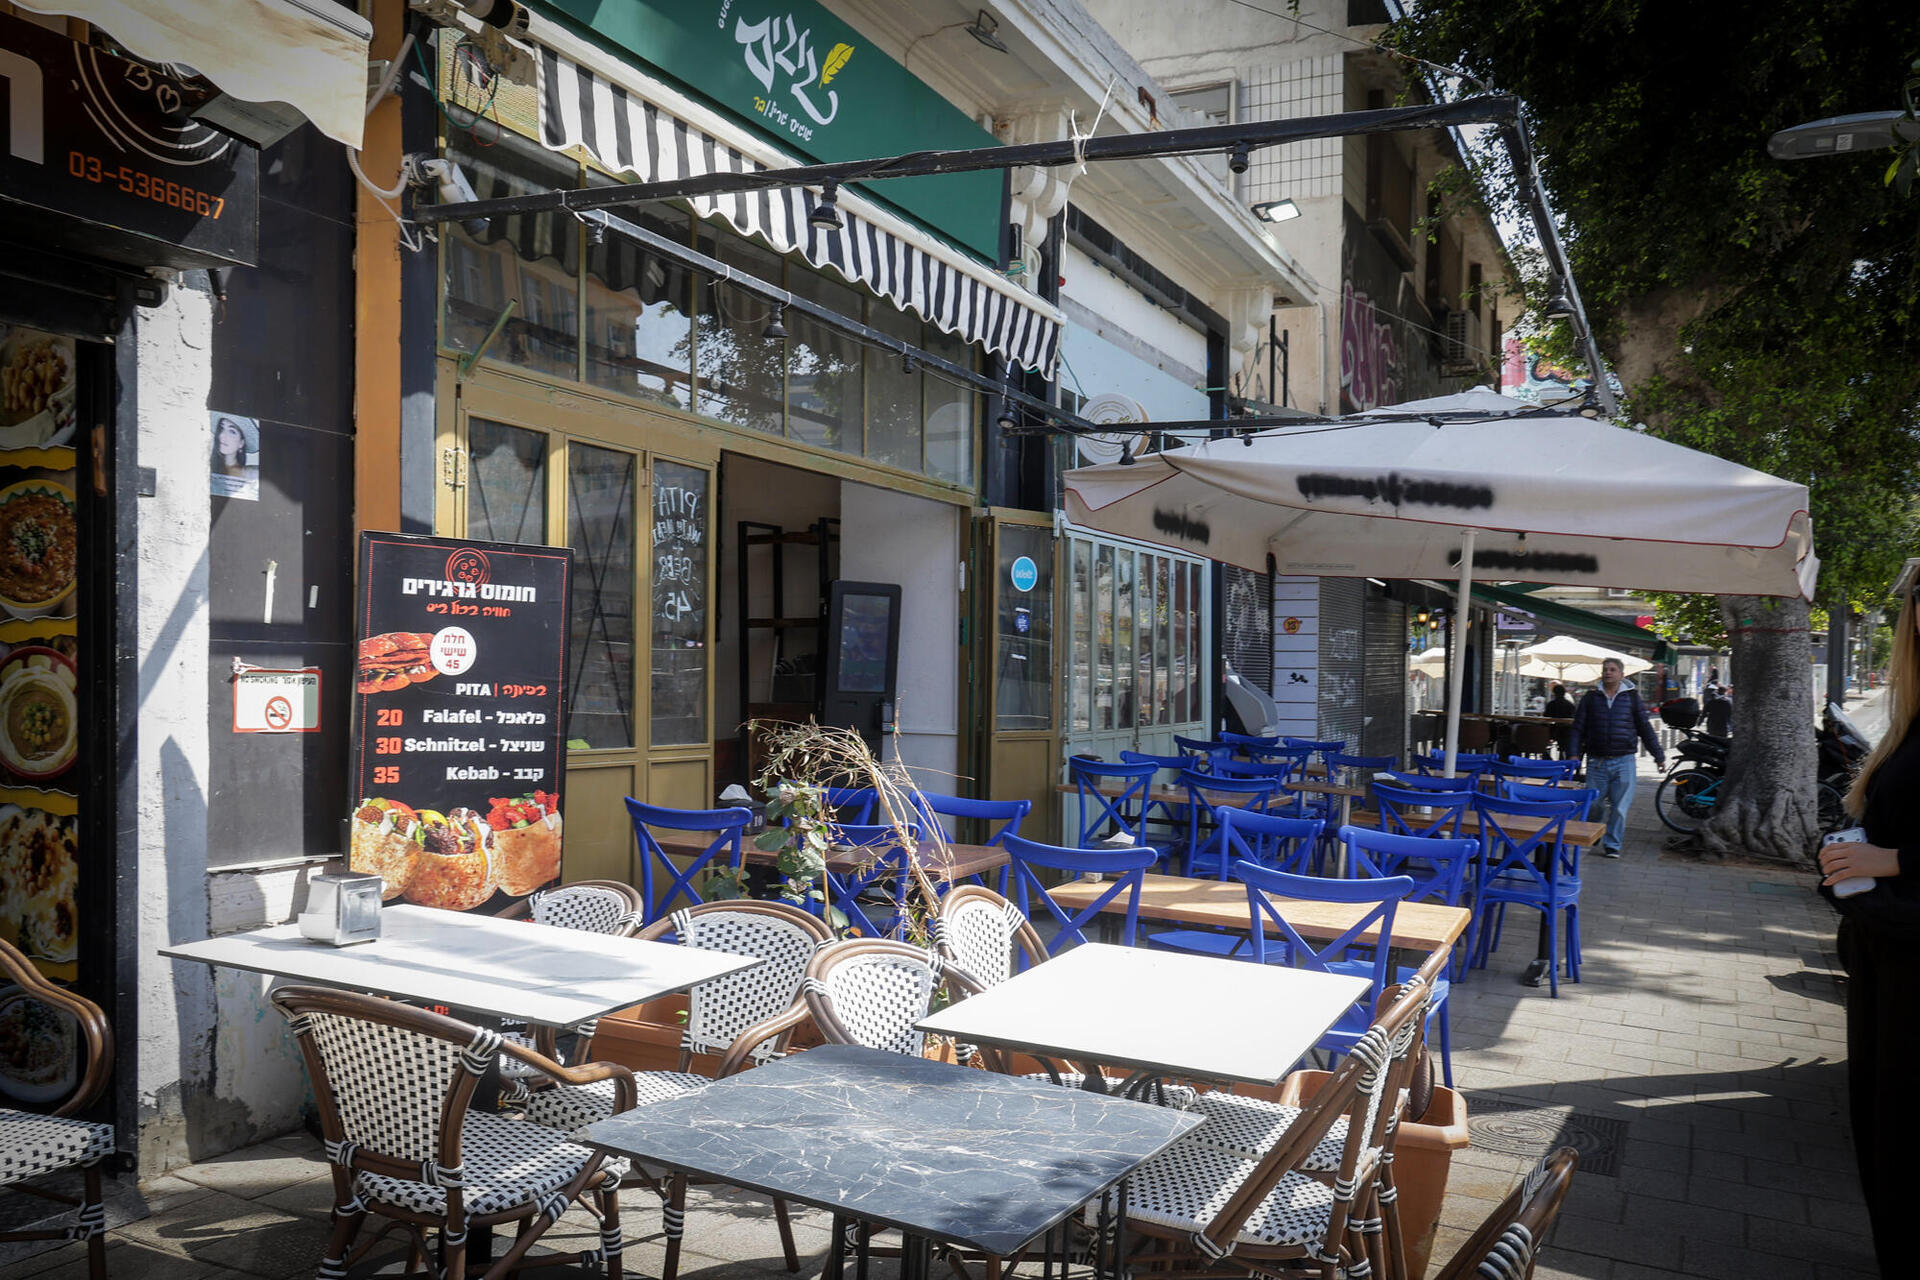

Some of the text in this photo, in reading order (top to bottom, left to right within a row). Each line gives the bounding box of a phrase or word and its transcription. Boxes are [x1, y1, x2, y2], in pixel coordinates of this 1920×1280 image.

[718, 0, 733, 29] GUG
[69, 151, 225, 220] 03-5366667
[402, 577, 536, 603] חומוס גרגירים
[426, 602, 449, 615] ביס
[482, 605, 512, 618] חוויה
[443, 634, 465, 644] חלת
[440, 647, 467, 657] שישי
[445, 659, 460, 669] 45
[455, 683, 492, 697] PITA
[501, 684, 547, 698] בפיתה
[376, 709, 403, 727] 20
[423, 709, 482, 724] Falafel
[496, 710, 546, 725] פלאפל
[375, 737, 402, 755] 30
[404, 737, 485, 752] Schnitzel
[500, 738, 545, 753] שניצל
[373, 766, 400, 784] 35
[446, 766, 499, 781] Kebab
[513, 768, 545, 782] קבב
[754, 815, 763, 827] 10
